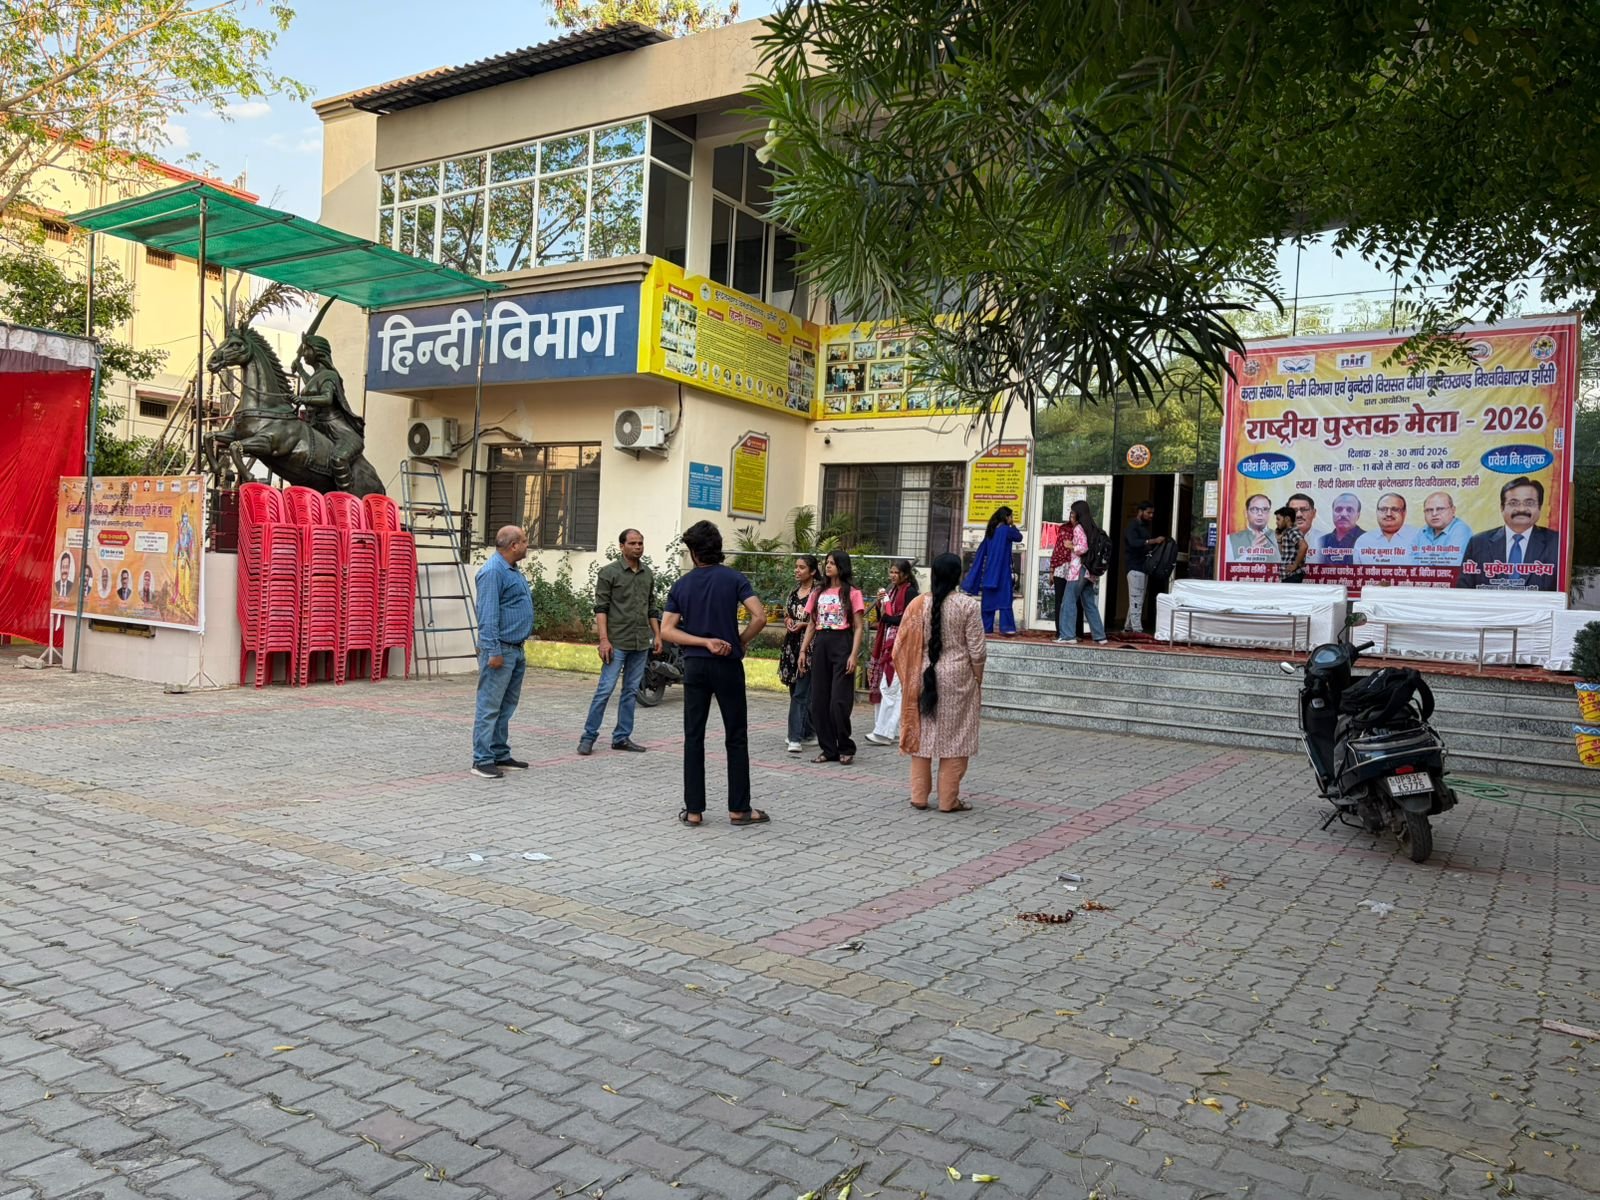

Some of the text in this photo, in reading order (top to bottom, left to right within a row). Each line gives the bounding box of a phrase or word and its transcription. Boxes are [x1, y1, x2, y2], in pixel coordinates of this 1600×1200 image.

[377, 300, 625, 375] हिन्दी विभाग
[1241, 387, 1257, 400] कला
[1260, 382, 1284, 401] संकाय,
[1287, 380, 1306, 399] हिन्दी
[1309, 378, 1332, 396] विभाग
[1335, 377, 1347, 395] एवं
[1348, 375, 1373, 401] बुन्देली
[1376, 373, 1404, 392] विरासत
[1475, 366, 1529, 387] विश्वविद्यालय
[1531, 363, 1556, 385] झाँसी
[1379, 396, 1410, 405] आयोजित
[1246, 410, 1318, 444] राष्ट्रीय
[1323, 414, 1400, 446] पुस्तक
[1405, 403, 1459, 433] मेला
[1483, 406, 1544, 431] 2026
[1348, 447, 1371, 458] दिनांक
[1410, 446, 1425, 457] मार्च
[1427, 448, 1448, 456] 2026
[1242, 459, 1258, 472] प्रवेश
[1313, 464, 1332, 472] समय
[1363, 463, 1370, 471] 11
[1371, 461, 1383, 471] बजे
[1385, 461, 1392, 471] से
[1418, 462, 1429, 470] 06
[1431, 459, 1444, 470] बजे
[1446, 460, 1460, 469] तक
[1487, 453, 1508, 466] प्रवेश
[1318, 478, 1333, 489] हिन्दी
[1335, 478, 1354, 488] विभाग
[1356, 477, 1376, 488] परिसर
[1377, 477, 1413, 490] बुन्देलखण्ड
[1361, 546, 1405, 557] प्रमोद कुमार सिंह
[1463, 559, 1554, 577] प्रो. मुकेश पाण्डेय
[1395, 774, 1423, 785] UP93C
[1398, 781, 1426, 792] K5775
